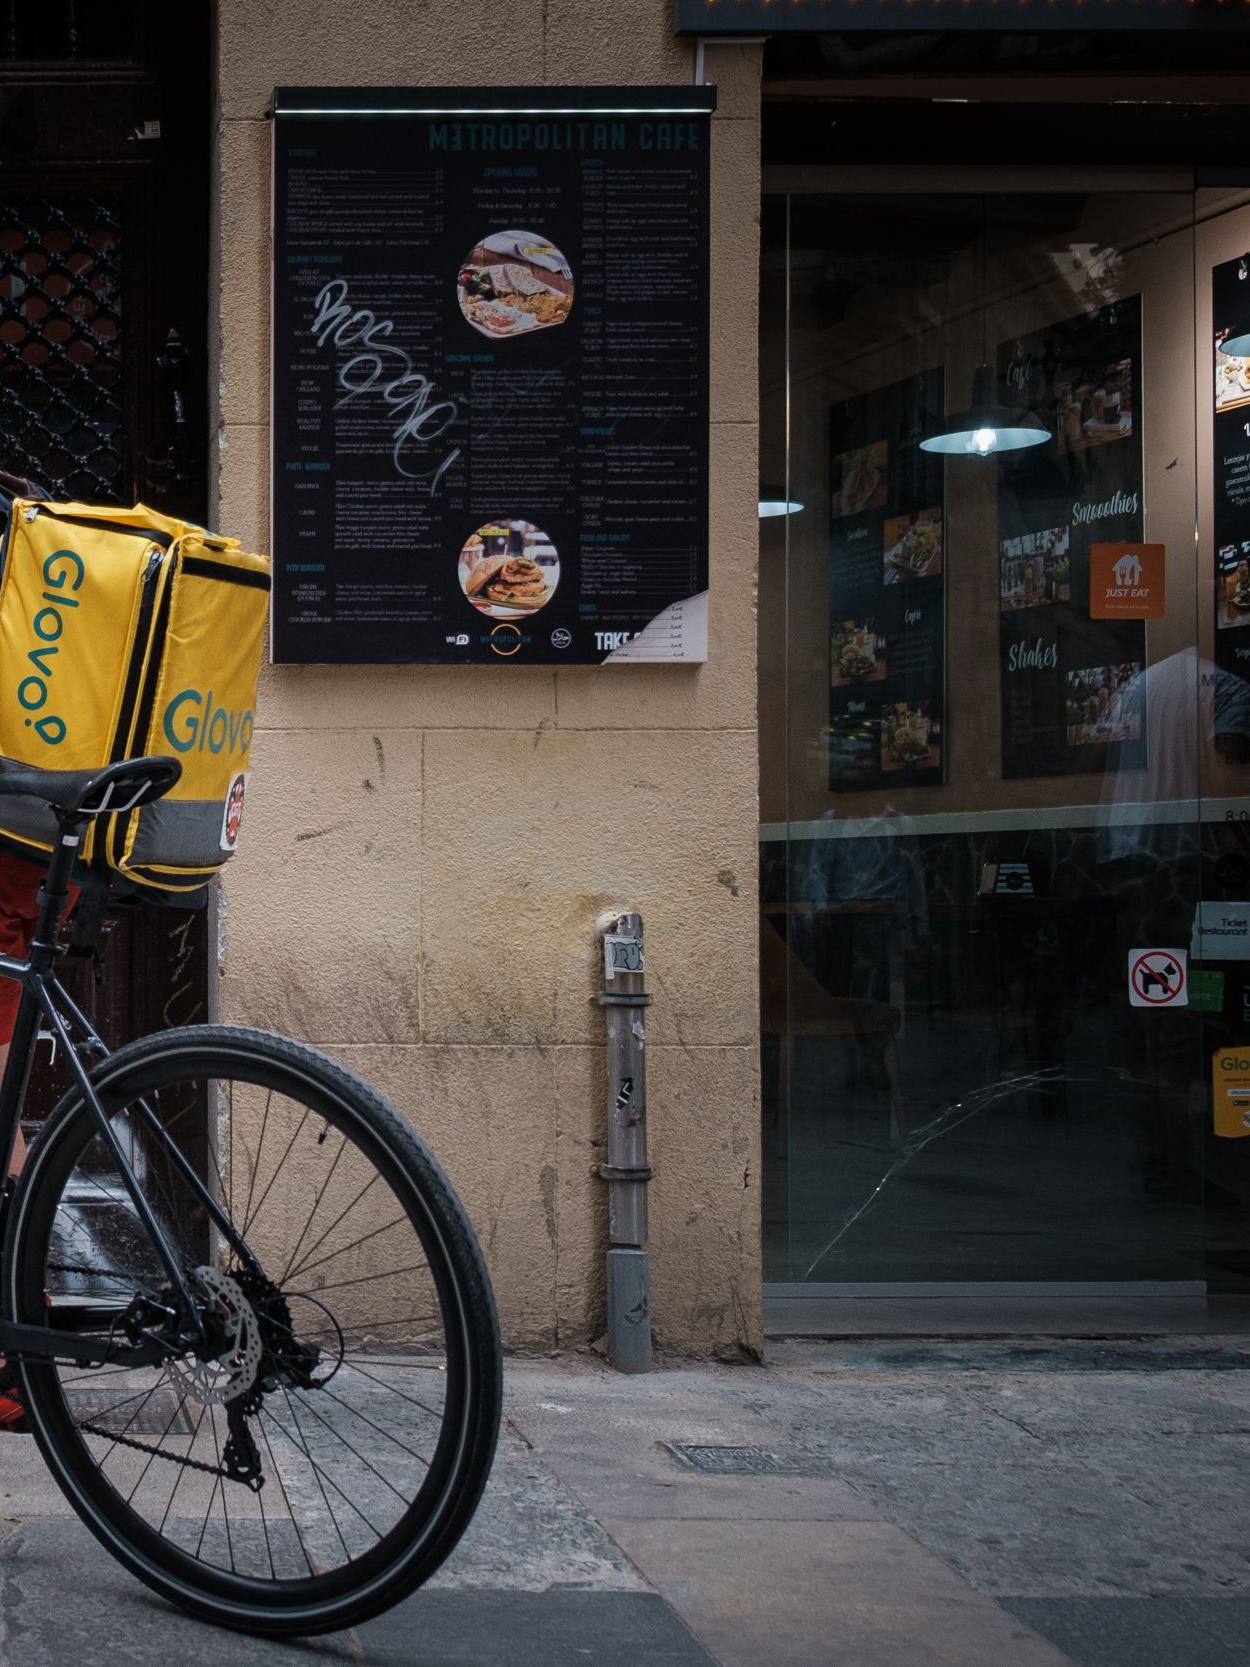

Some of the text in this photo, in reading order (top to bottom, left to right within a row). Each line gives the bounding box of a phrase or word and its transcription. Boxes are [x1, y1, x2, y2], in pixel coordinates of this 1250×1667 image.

[638, 123, 699, 151] CAFE
[1105, 588, 1150, 598] JUST EAT
[17, 550, 84, 711] Glovo
[1008, 638, 1059, 672] Shakes
[163, 690, 253, 755] Glovo
